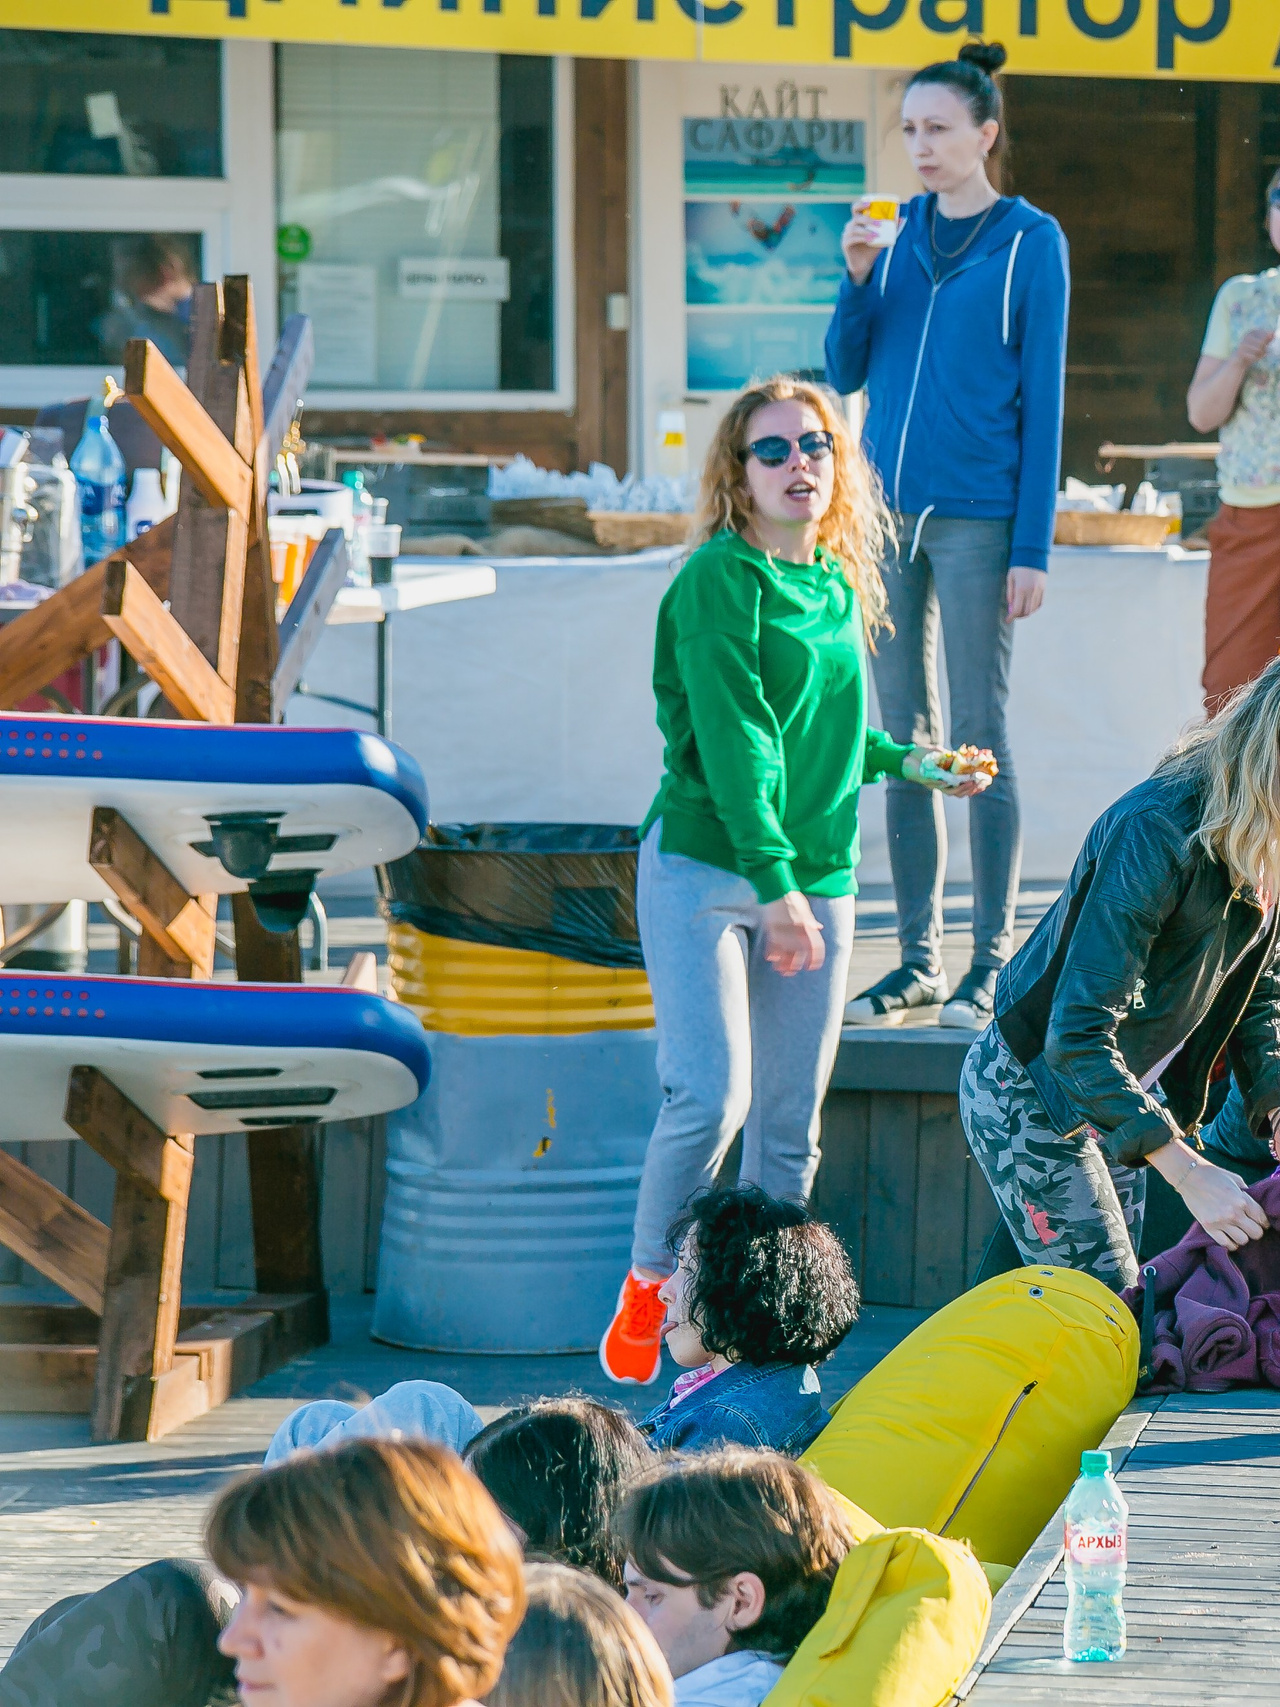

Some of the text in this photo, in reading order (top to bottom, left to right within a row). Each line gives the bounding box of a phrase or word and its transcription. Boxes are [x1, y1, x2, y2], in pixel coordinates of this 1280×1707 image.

[719, 78, 828, 118] КАЙТ
[688, 119, 856, 153] САФАРИ
[1078, 1535, 1122, 1549] АРХЫЗ
